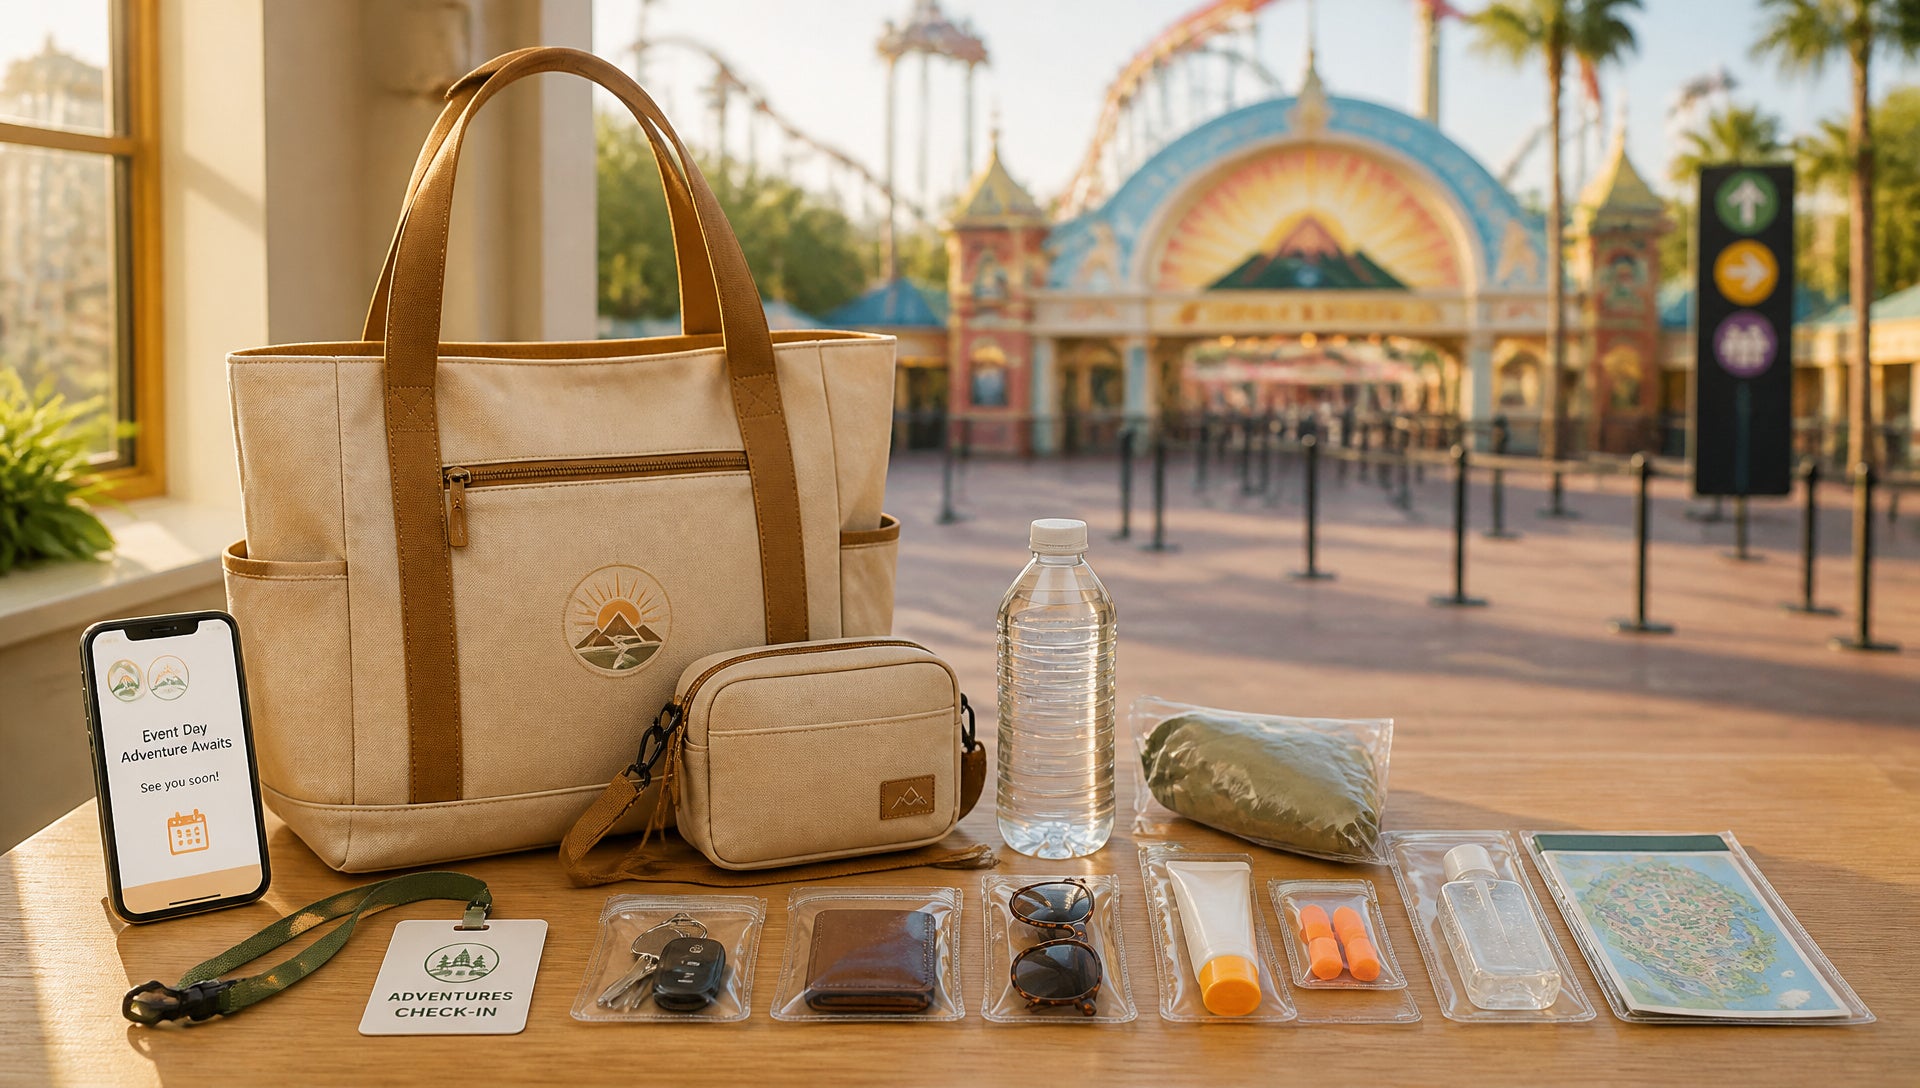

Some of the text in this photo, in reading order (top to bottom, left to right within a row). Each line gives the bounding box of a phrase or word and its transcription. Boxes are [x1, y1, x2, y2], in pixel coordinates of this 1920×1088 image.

[142, 726, 179, 743] Event
[121, 737, 233, 763] Adventure Awaits
[140, 771, 220, 794] See you soon!
[387, 991, 514, 1002] ADVENTURES
[394, 1006, 498, 1018] CHECK-IN
